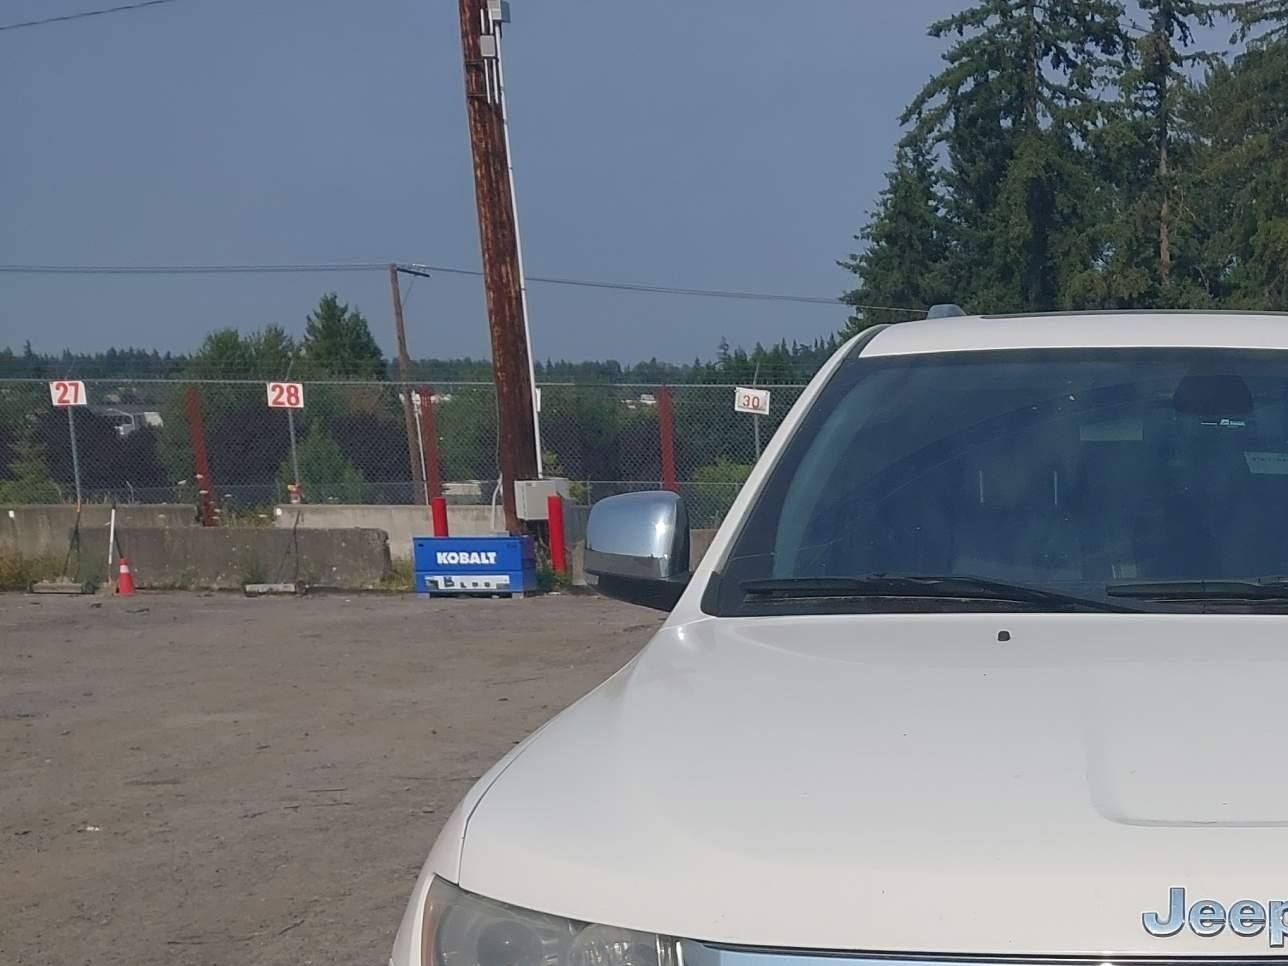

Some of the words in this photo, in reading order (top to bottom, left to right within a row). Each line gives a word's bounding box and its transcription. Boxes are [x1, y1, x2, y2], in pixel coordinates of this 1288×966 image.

[54, 382, 82, 405] 27
[271, 383, 301, 406] 28
[742, 395, 762, 410] 30
[436, 552, 497, 564] KOBALT
